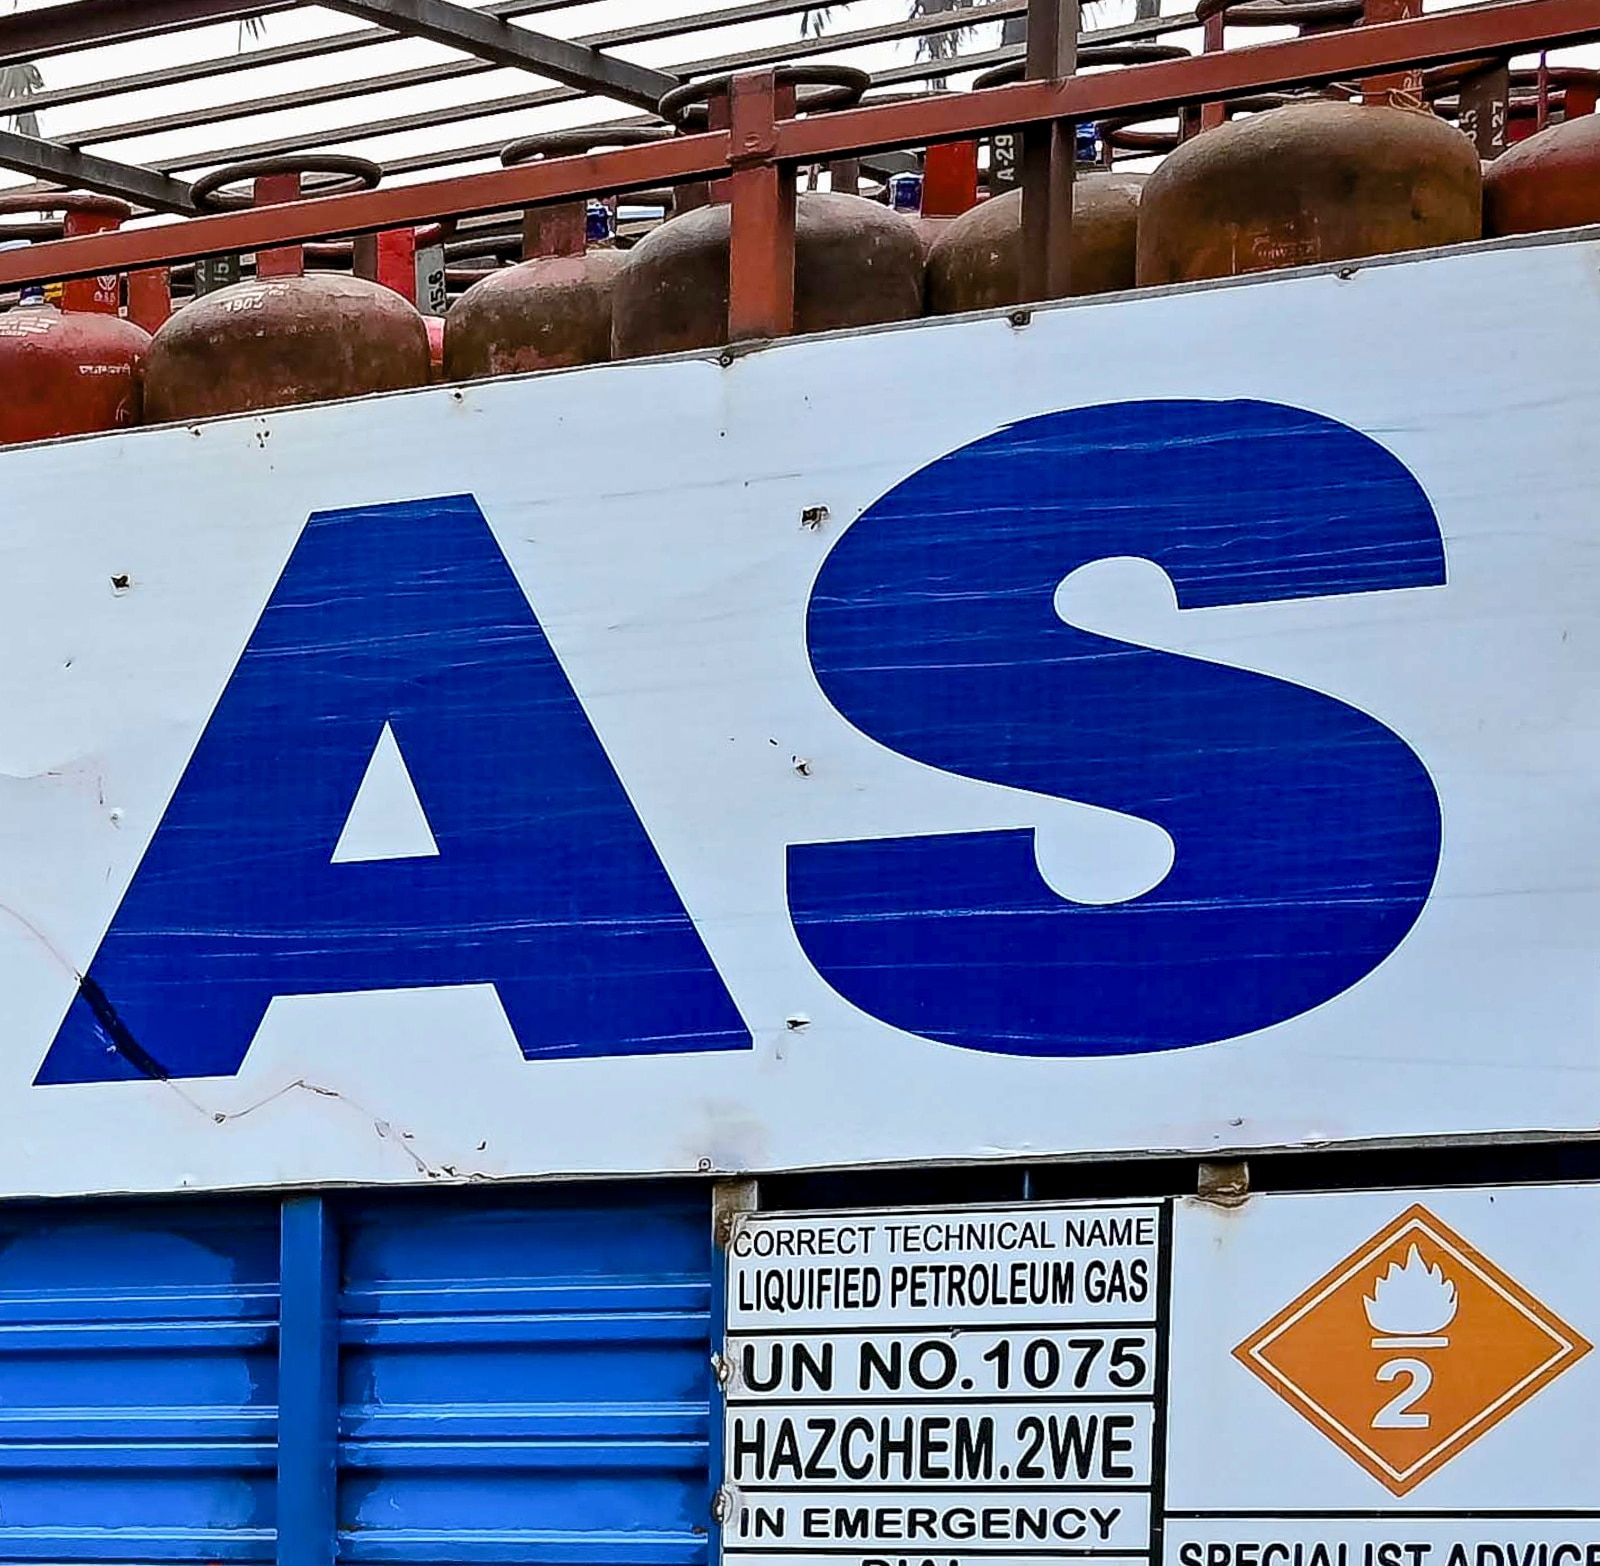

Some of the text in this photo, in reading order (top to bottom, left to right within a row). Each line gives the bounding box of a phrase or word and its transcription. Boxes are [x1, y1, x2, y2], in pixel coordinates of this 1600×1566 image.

[994, 133, 1015, 181] A-29
[429, 269, 446, 313] 15.6
[732, 1217, 1155, 1258] CORRECT TECHNICAL NAME
[738, 1258, 1149, 1313] LIQUIFIED PETROLEUM GAS
[742, 1342, 834, 1392] UN
[1371, 1358, 1434, 1429] 2
[733, 1415, 1135, 1481] HAZCHEM.2WE
[740, 1507, 1121, 1541] IN EMERGENCY
